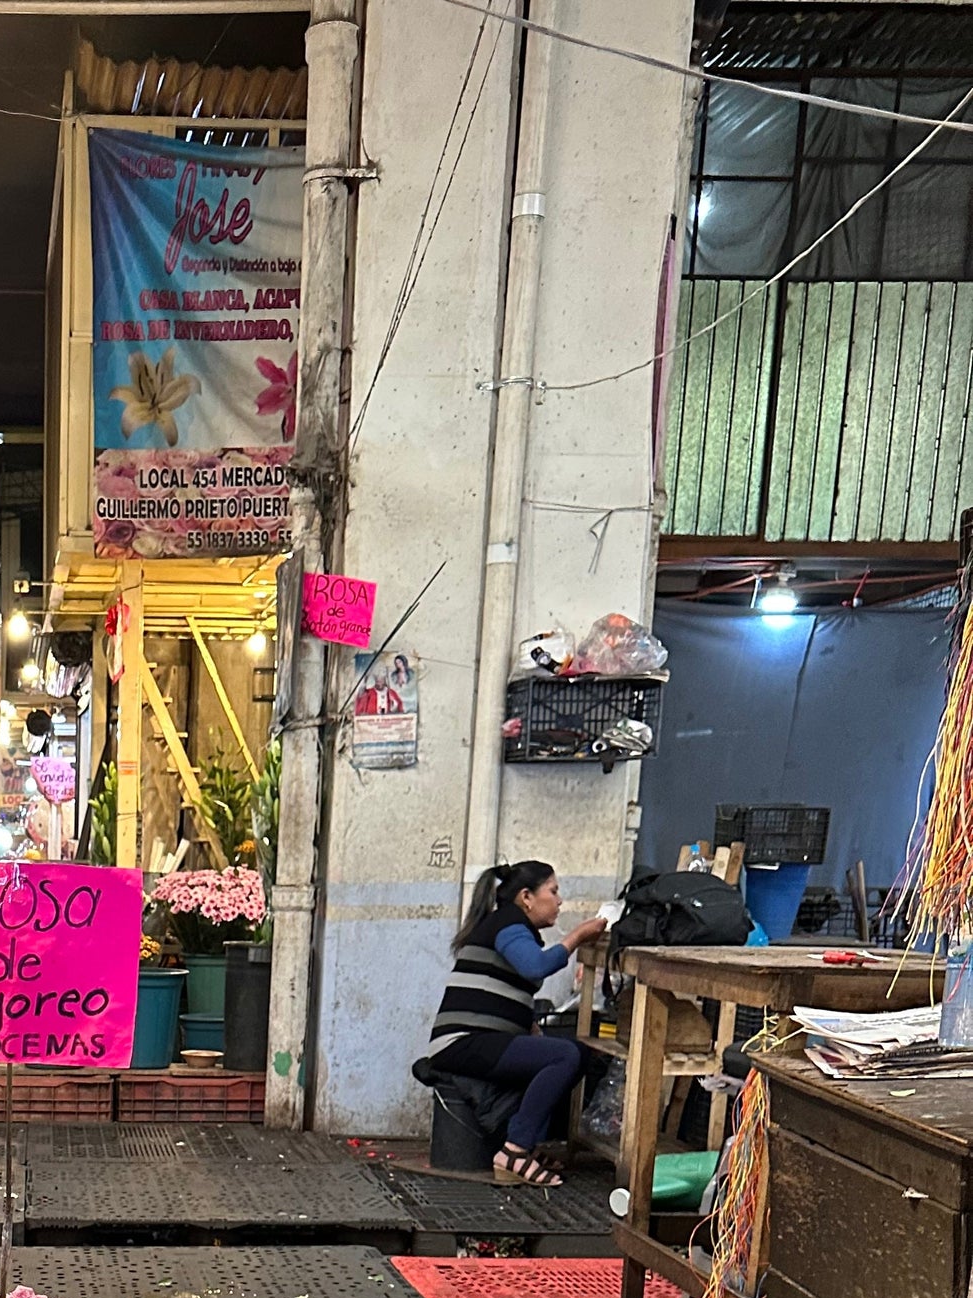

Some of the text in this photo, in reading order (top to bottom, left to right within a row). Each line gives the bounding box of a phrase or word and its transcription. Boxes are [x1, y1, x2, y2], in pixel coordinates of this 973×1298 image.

[164, 161, 253, 275] Jose
[222, 260, 228, 275] y
[270, 261, 276, 272] a
[278, 257, 296, 275] bajo
[140, 289, 180, 310] CASA
[182, 290, 249, 313] BLANCA,
[100, 321, 145, 340] ROSA
[148, 320, 170, 340] DE
[174, 319, 293, 342] INVERNADERO,
[139, 468, 188, 489] LOCAL
[193, 470, 217, 487] 454
[97, 498, 180, 518] GUILLERMO
[185, 498, 238, 518] PRIETO
[187, 534, 201, 548] 55
[207, 533, 233, 548] 1837
[238, 532, 268, 546] 3339
[314, 575, 368, 606] ROSA
[328, 605, 345, 618] de
